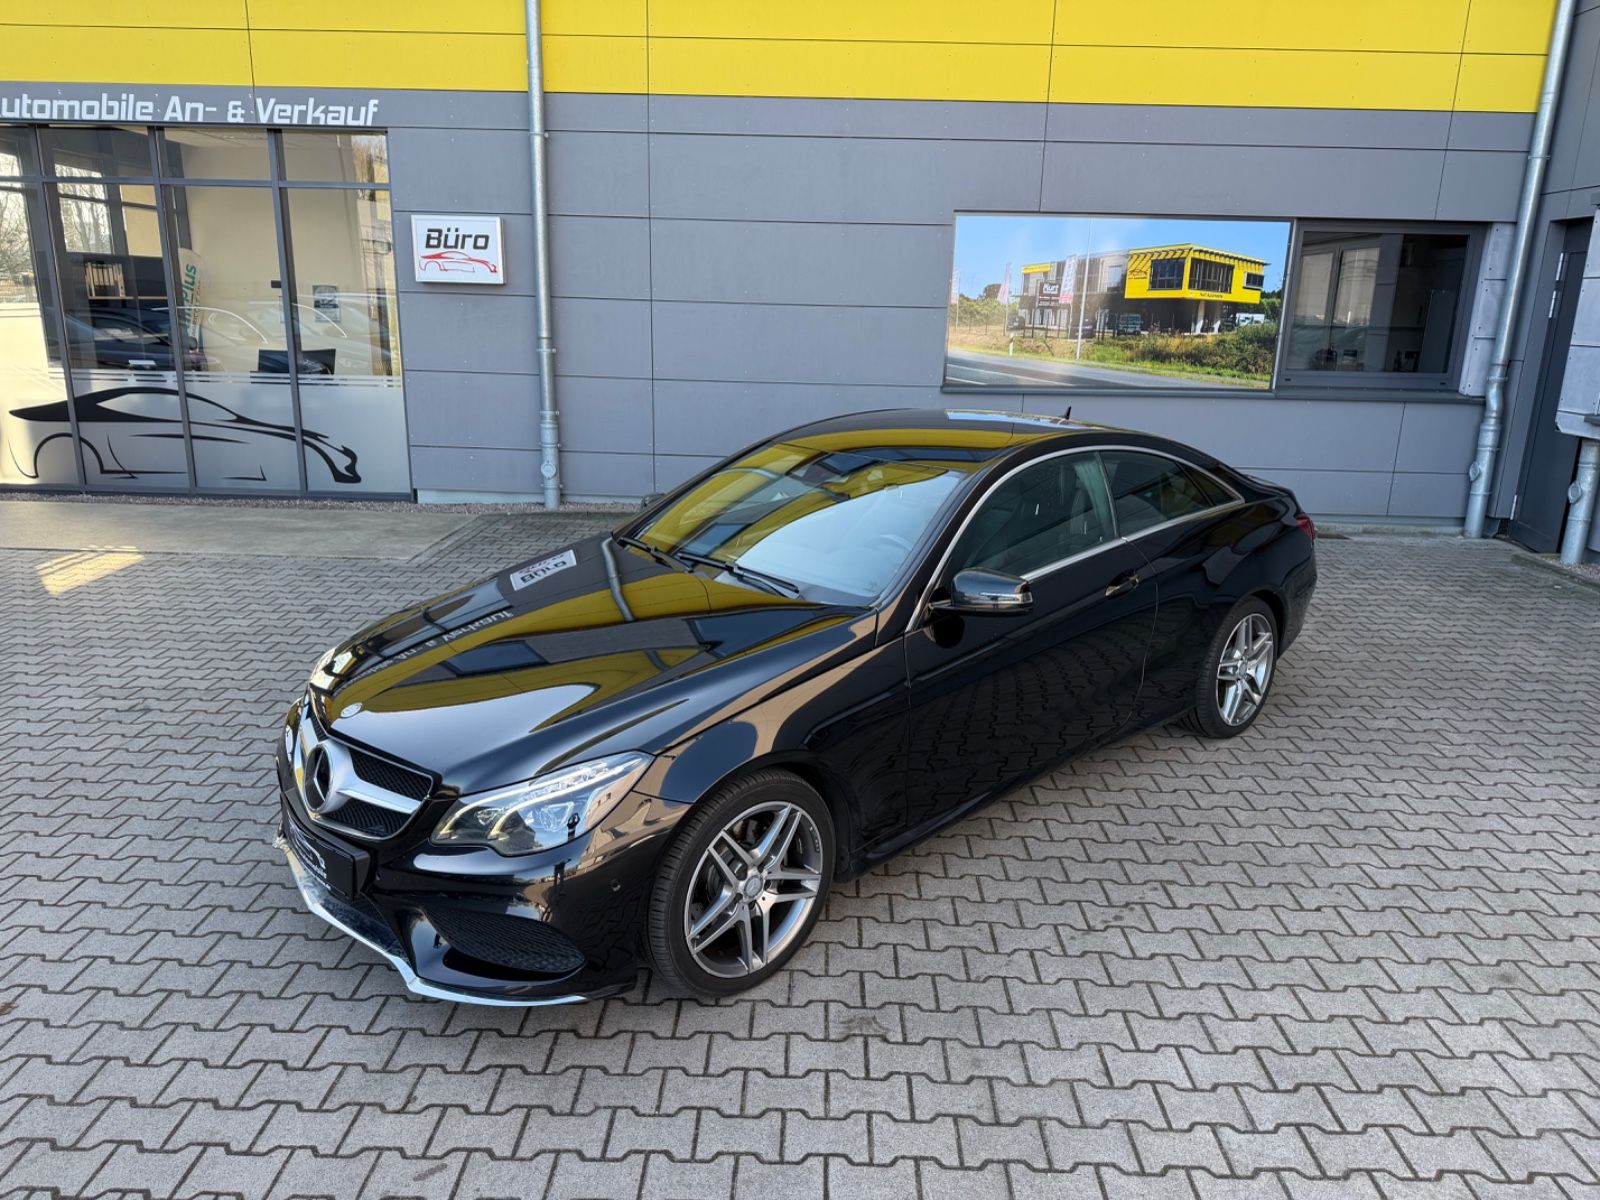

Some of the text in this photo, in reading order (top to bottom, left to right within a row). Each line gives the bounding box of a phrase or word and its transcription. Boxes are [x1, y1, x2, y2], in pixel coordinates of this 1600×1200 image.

[0, 93, 379, 126] utomobile An- & Verkauf
[425, 227, 490, 250] Büro
